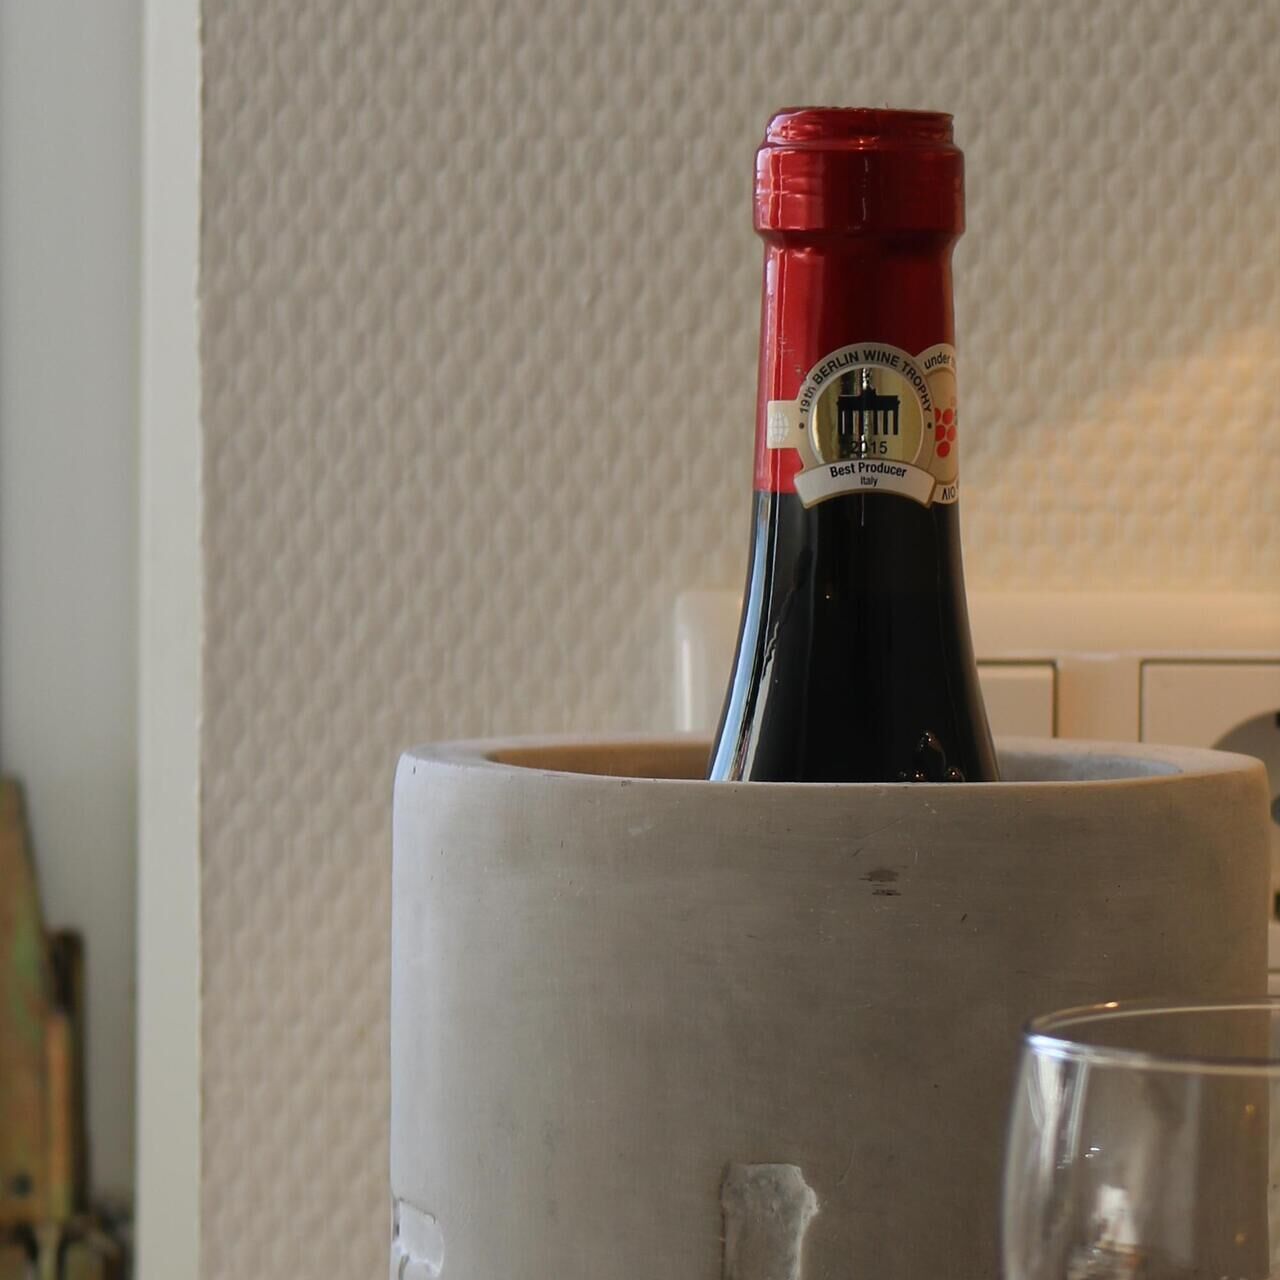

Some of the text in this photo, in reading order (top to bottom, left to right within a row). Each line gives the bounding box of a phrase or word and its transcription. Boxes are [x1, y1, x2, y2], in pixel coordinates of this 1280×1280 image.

[924, 352, 951, 369] under
[800, 349, 933, 414] 19th BERLIN WINE TROPHY
[850, 440, 888, 455] 2015
[830, 462, 907, 478] Best Producer
[860, 476, 879, 487] Italy
